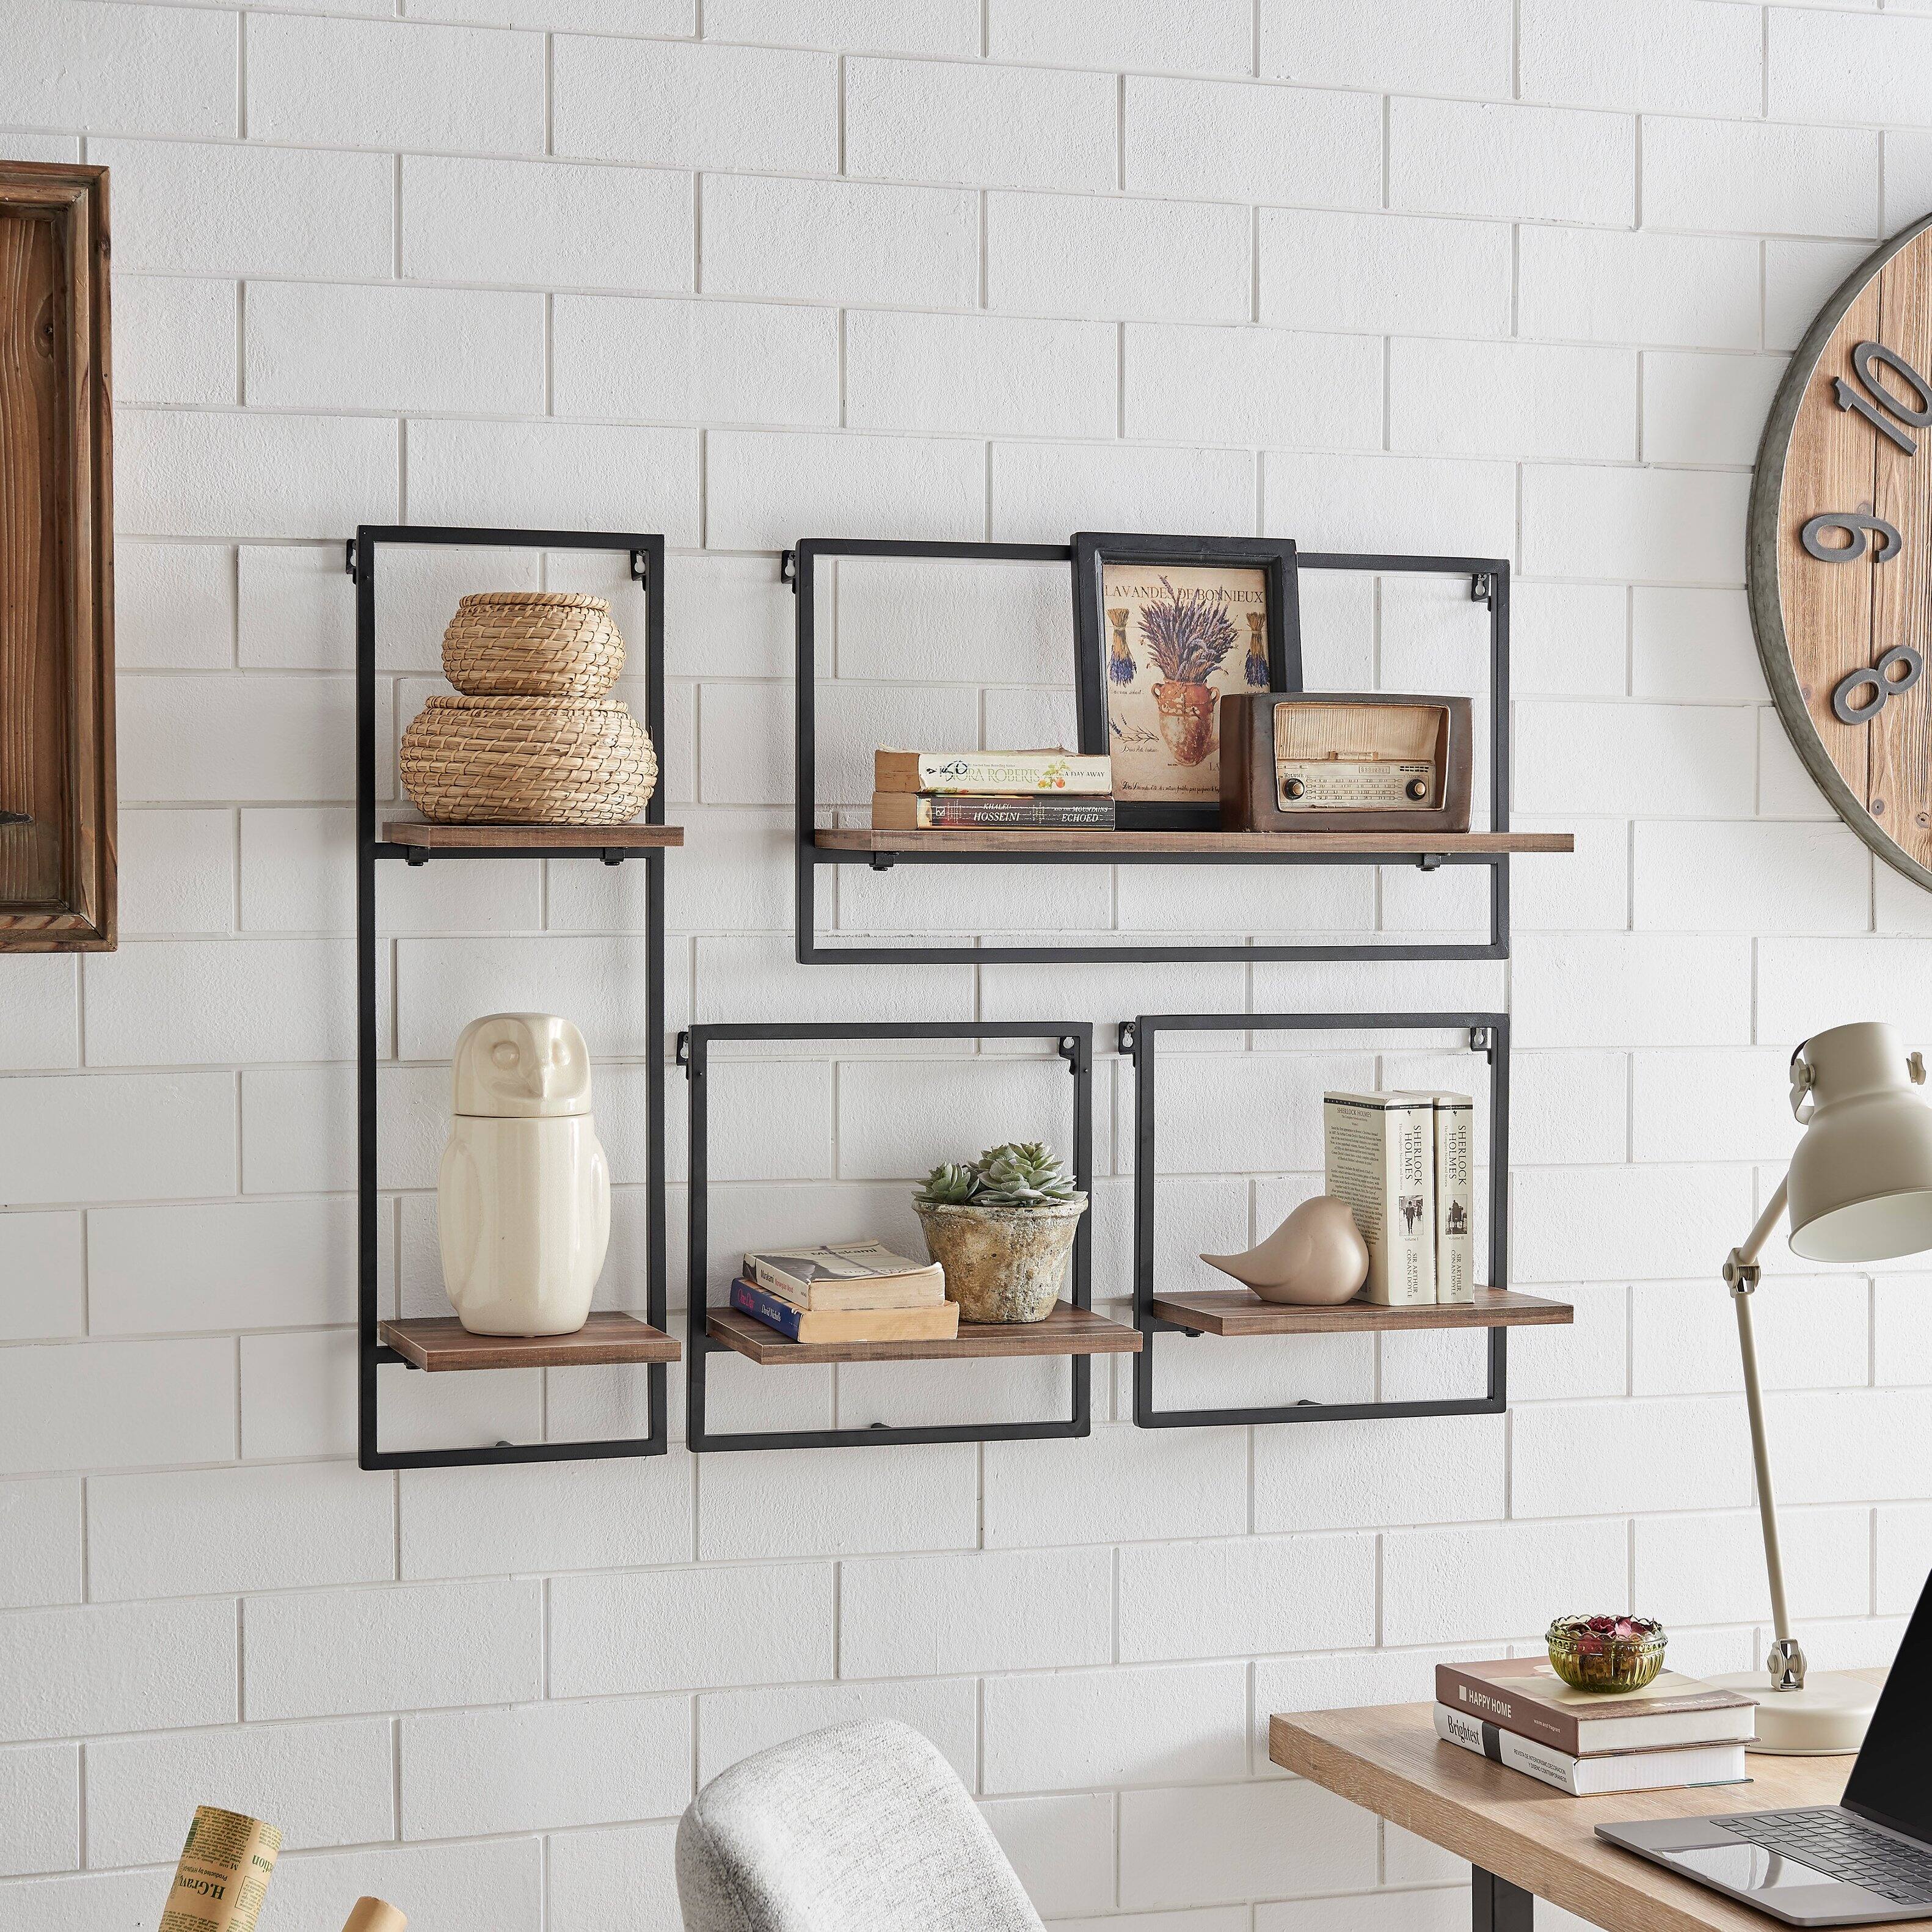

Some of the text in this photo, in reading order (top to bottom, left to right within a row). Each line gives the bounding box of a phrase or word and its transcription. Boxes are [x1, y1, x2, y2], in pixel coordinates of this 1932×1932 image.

[1831, 341, 1932, 457] 10
[1799, 512, 1903, 564] 9
[1177, 587, 1194, 600] DE
[1831, 645, 1923, 726] 8
[988, 768, 1040, 784] ROBERTS
[974, 812, 1021, 822] HOSSEINI
[1061, 813, 1099, 822] ECHOED
[1336, 1107, 1372, 1118] SHERLOCK HOLMES
[1404, 1133, 1413, 1179] HOLMES
[1413, 1125, 1423, 1186] SHERLOCK
[1448, 1133, 1457, 1179] HOLMES
[1457, 1125, 1467, 1186] SHERLOCK
[810, 1247, 878, 1256] Murakami
[760, 1269, 775, 1283] Murakami
[775, 1278, 787, 1290] Norwegian
[737, 1288, 746, 1305] One
[761, 1304, 781, 1322] David Nicholls
[1468, 1689, 1512, 1719] HAPPY HOME
[1446, 1714, 1481, 1746] Brightest
[1548, 1723, 1562, 1733] fragrant
